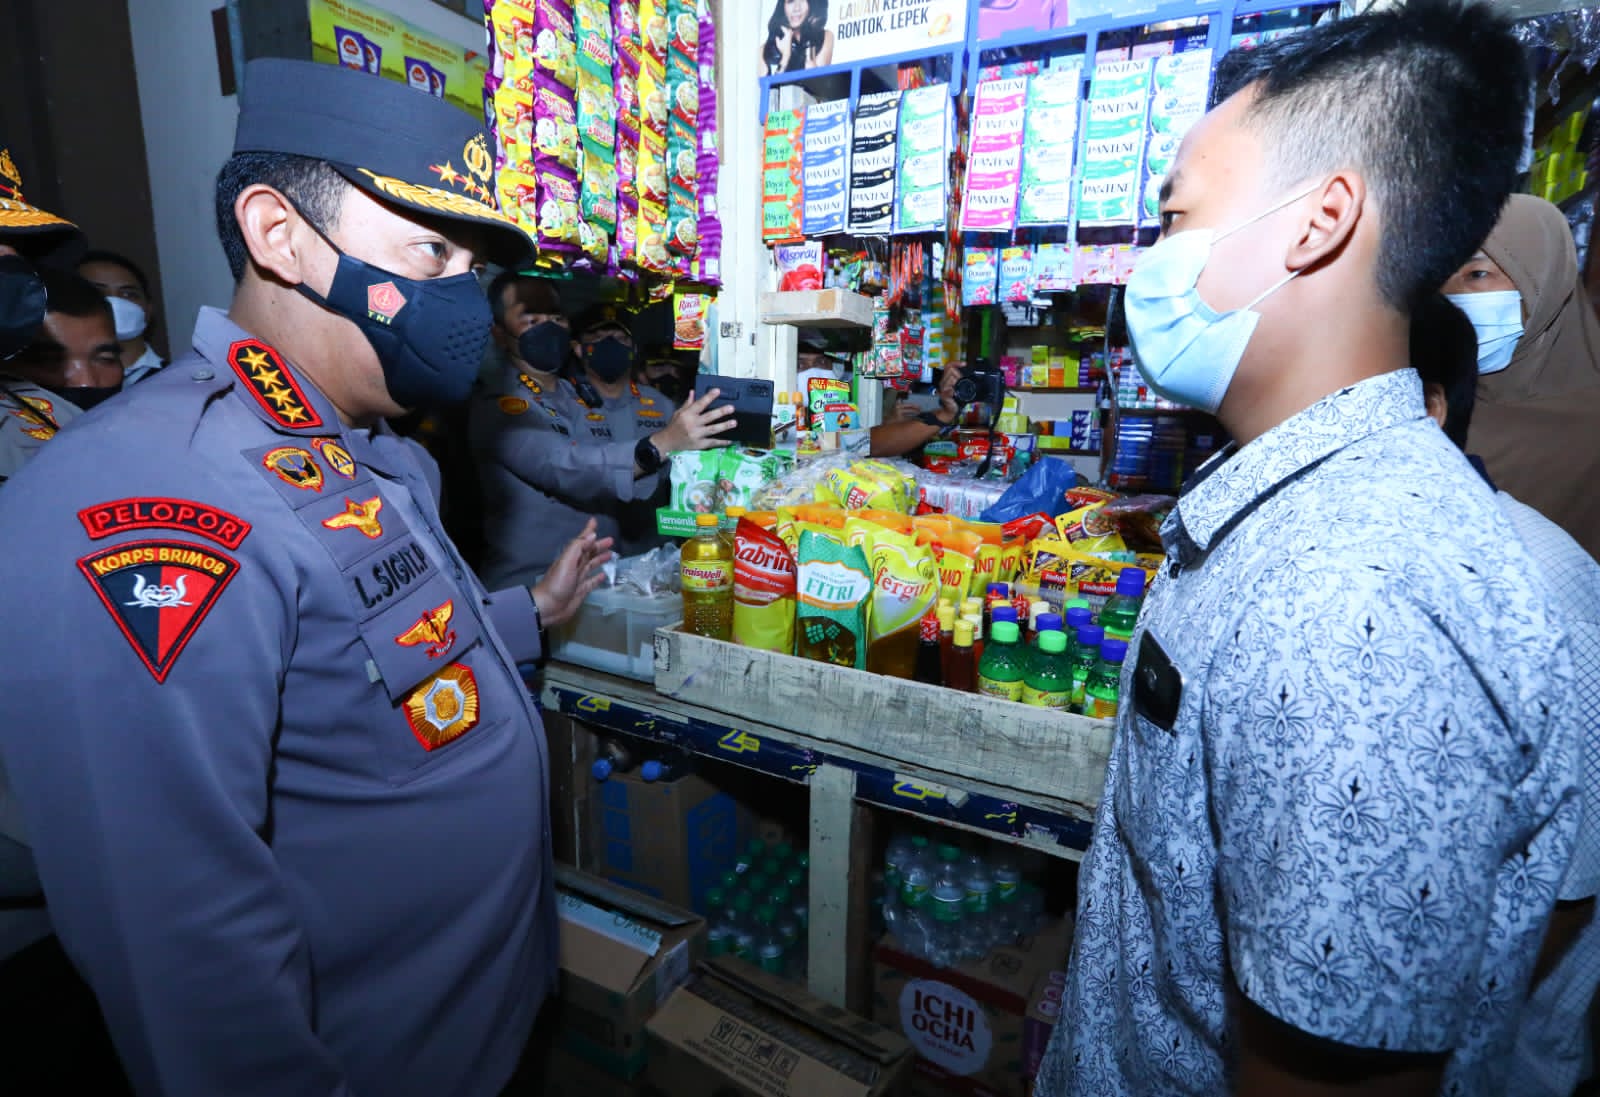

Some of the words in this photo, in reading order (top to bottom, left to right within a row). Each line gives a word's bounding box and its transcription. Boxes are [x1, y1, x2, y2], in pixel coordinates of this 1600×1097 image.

[890, 7, 928, 30] LEPEK
[367, 311, 393, 326] TNI
[95, 503, 239, 541] PELOPOR
[659, 513, 697, 528] lemonil
[93, 547, 155, 575] KORPS
[159, 547, 227, 576] BRIMOB
[735, 536, 794, 573] Sabrin
[804, 577, 854, 601] FITRI
[915, 990, 975, 1032] ICHI
[912, 1014, 975, 1051] OCHA
